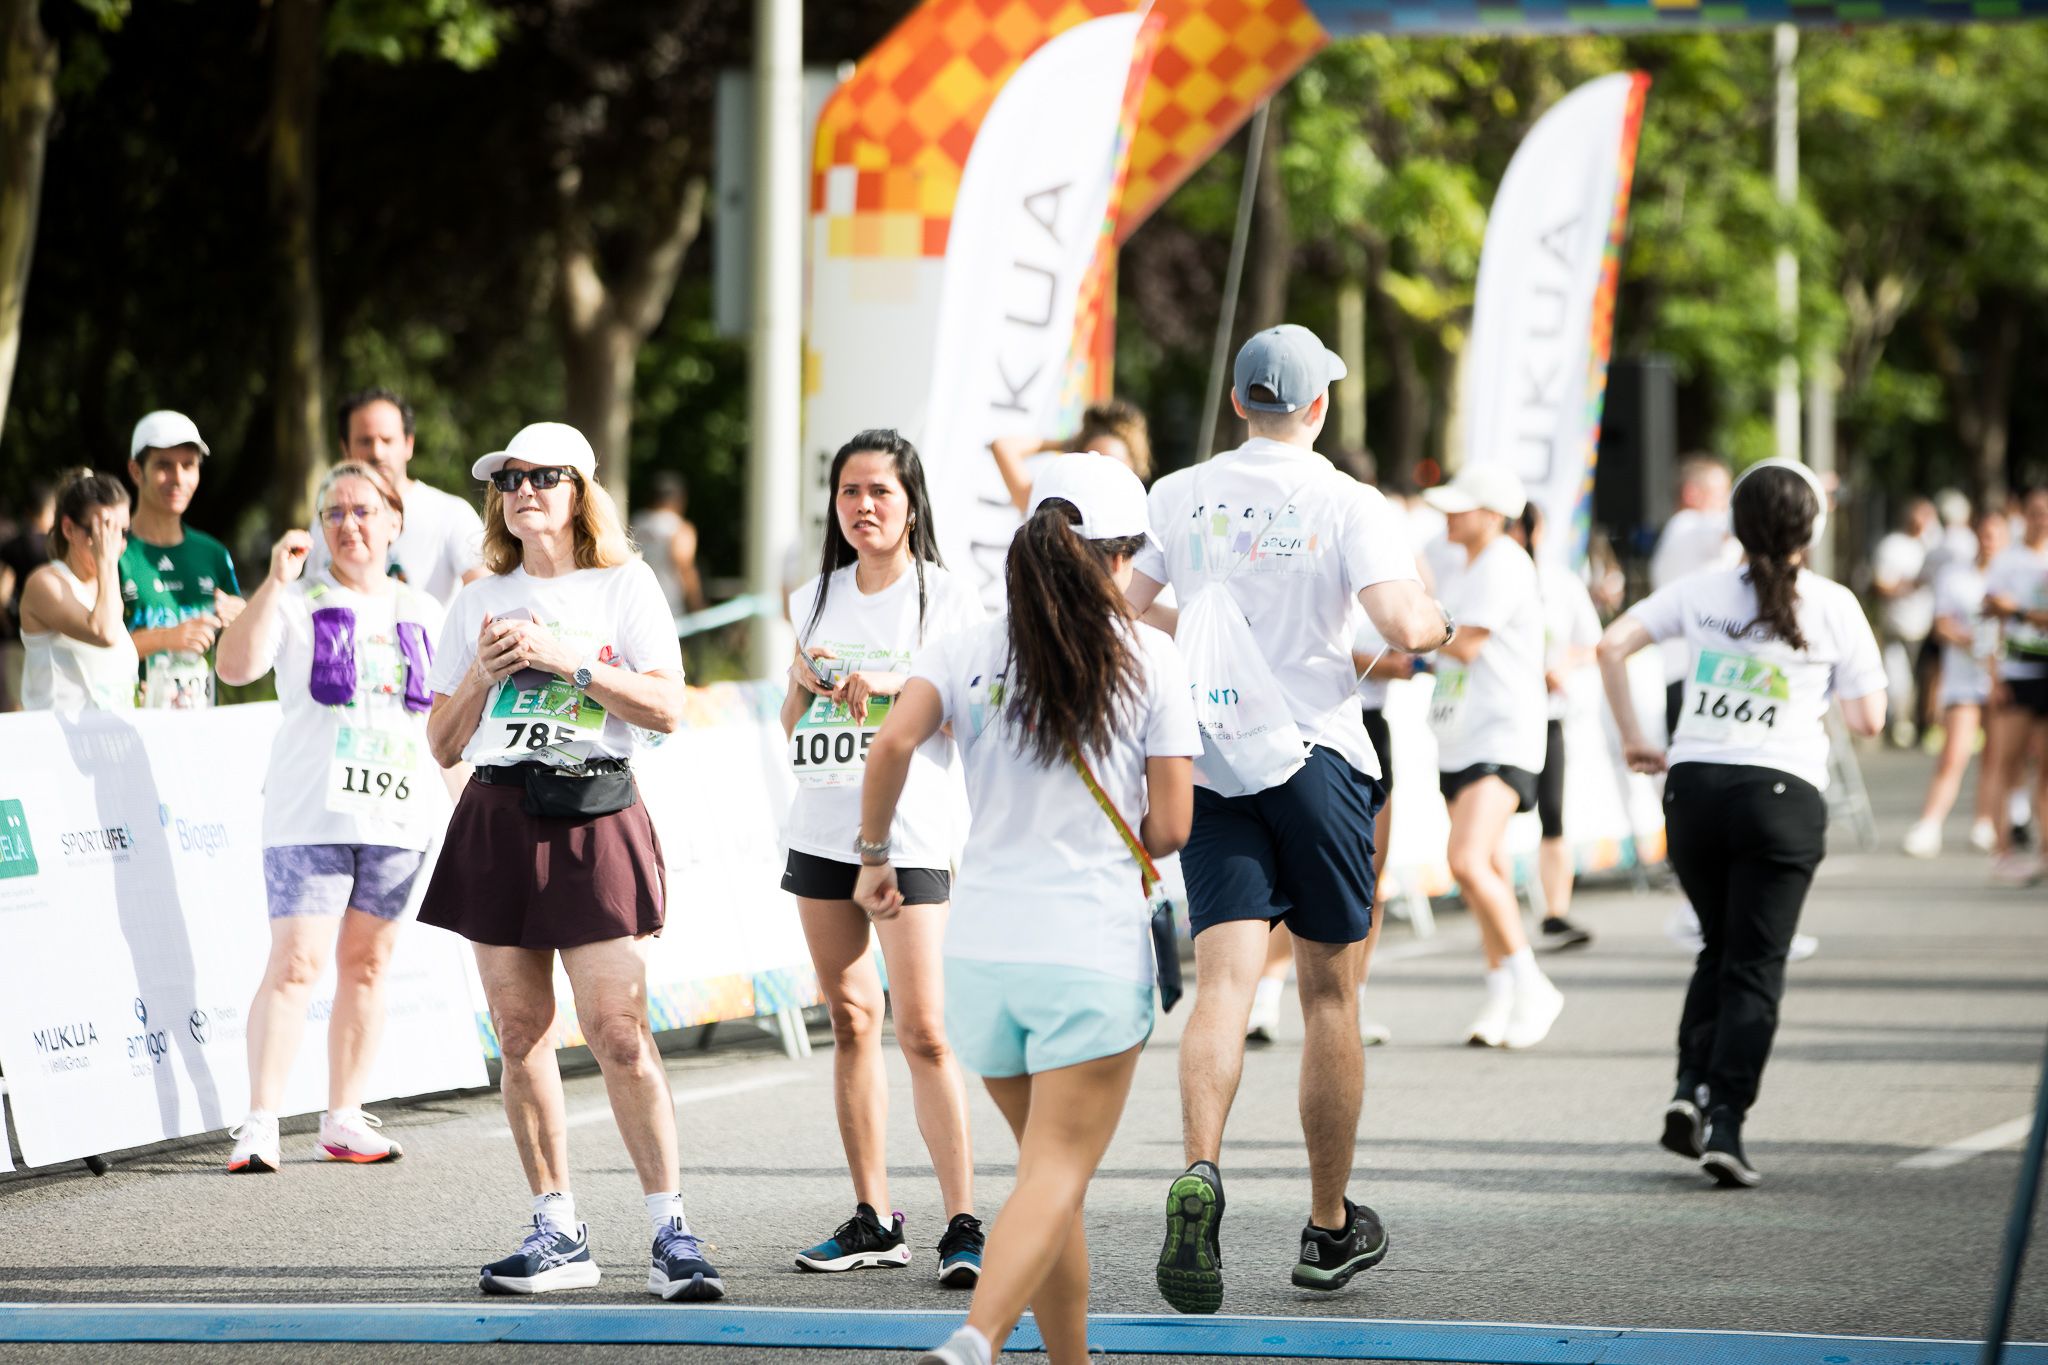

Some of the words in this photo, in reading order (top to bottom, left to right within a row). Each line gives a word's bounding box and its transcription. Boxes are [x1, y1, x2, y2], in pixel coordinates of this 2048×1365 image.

[1517, 212, 1583, 483] UKUA
[868, 649, 891, 659] CON
[511, 690, 580, 722] ELA
[552, 686, 568, 694] CON
[1694, 691, 1776, 728] 1664
[342, 766, 410, 800] 1196
[175, 819, 230, 858] Biogen
[32, 1021, 99, 1054] MUKUA
[126, 1030, 168, 1064] amigo
